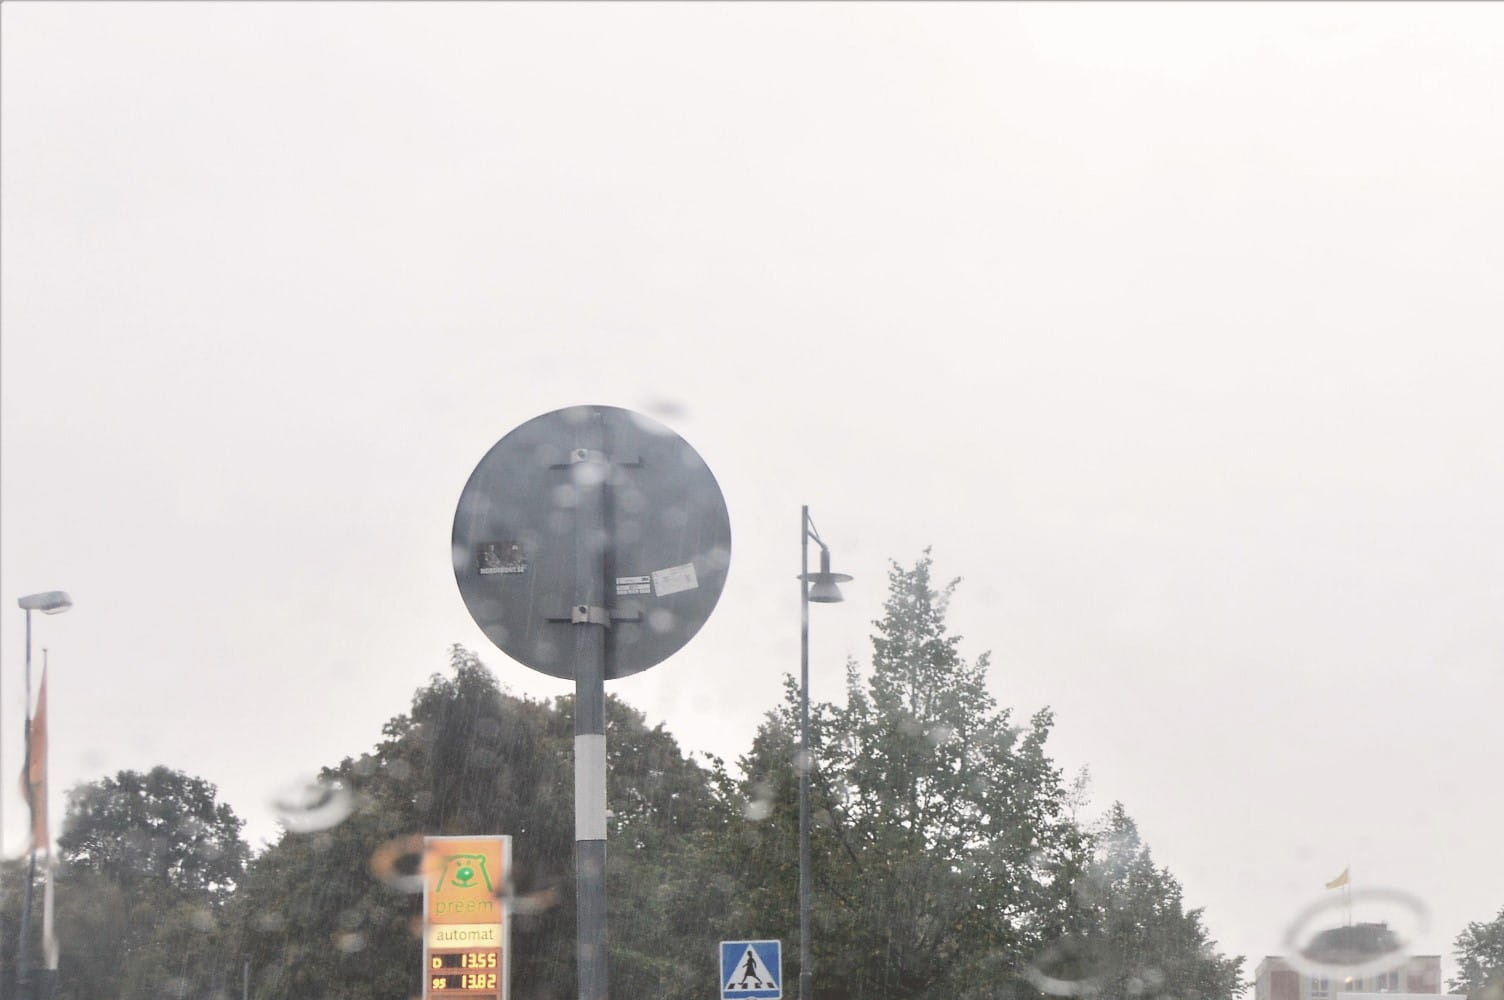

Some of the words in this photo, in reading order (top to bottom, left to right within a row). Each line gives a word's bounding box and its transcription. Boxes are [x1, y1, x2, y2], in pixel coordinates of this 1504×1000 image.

[435, 899, 493, 915] preem
[436, 928, 494, 941] automat
[432, 957, 442, 968] D
[461, 953, 497, 968] 13.55
[432, 978, 446, 989] 95
[461, 974, 497, 989] 13.82
